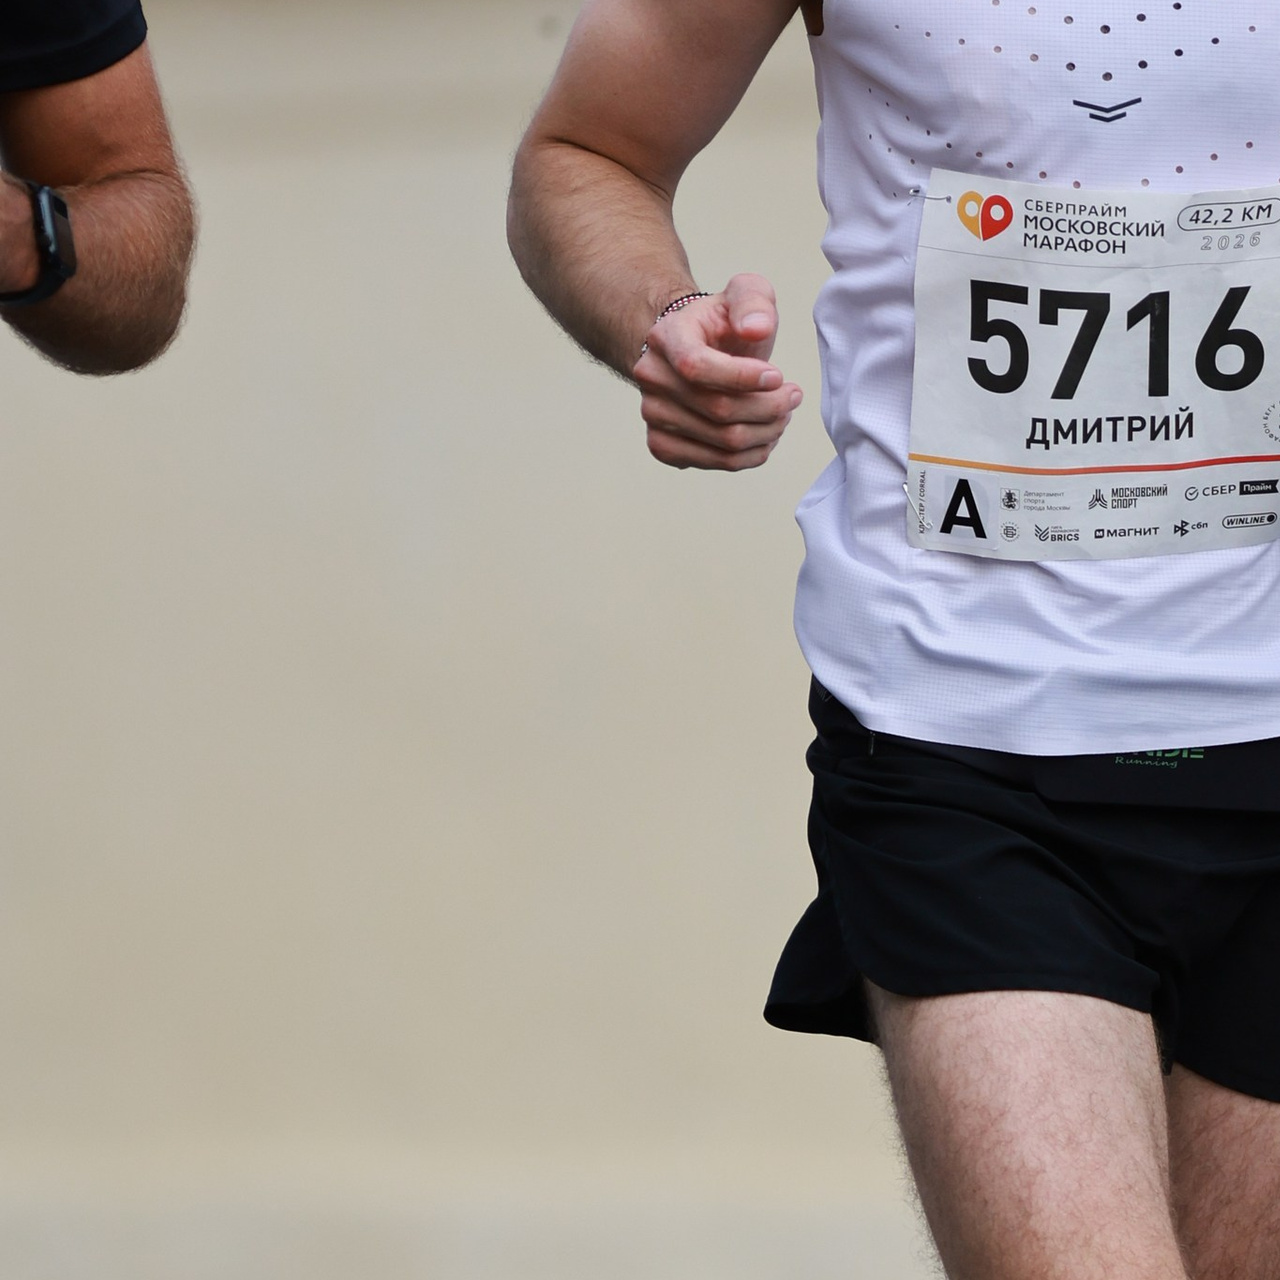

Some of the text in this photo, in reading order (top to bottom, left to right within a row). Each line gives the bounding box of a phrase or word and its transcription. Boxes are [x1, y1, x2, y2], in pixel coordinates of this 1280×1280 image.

[1024, 198, 1127, 218] СБЕРПРАЙМ
[1189, 204, 1273, 226] 42,2 КМ
[1023, 214, 1165, 237] МОСКОВСКИЙ
[1023, 232, 1126, 254] МАРАФОН
[1200, 231, 1261, 251] 2026
[967, 278, 1265, 400] 5716
[1025, 406, 1195, 451] ДМИТРИЙ
[1111, 483, 1168, 498] МОСКОВСКИЙ
[1202, 483, 1272, 497] СБЕР Прайм
[1111, 498, 1138, 509] СПОРТ
[1191, 521, 1208, 530] сбп
[1226, 516, 1266, 526] WINLINE
[1050, 533, 1080, 542] BRICS
[1106, 526, 1160, 538] магнит
[1115, 756, 1178, 769] Running
